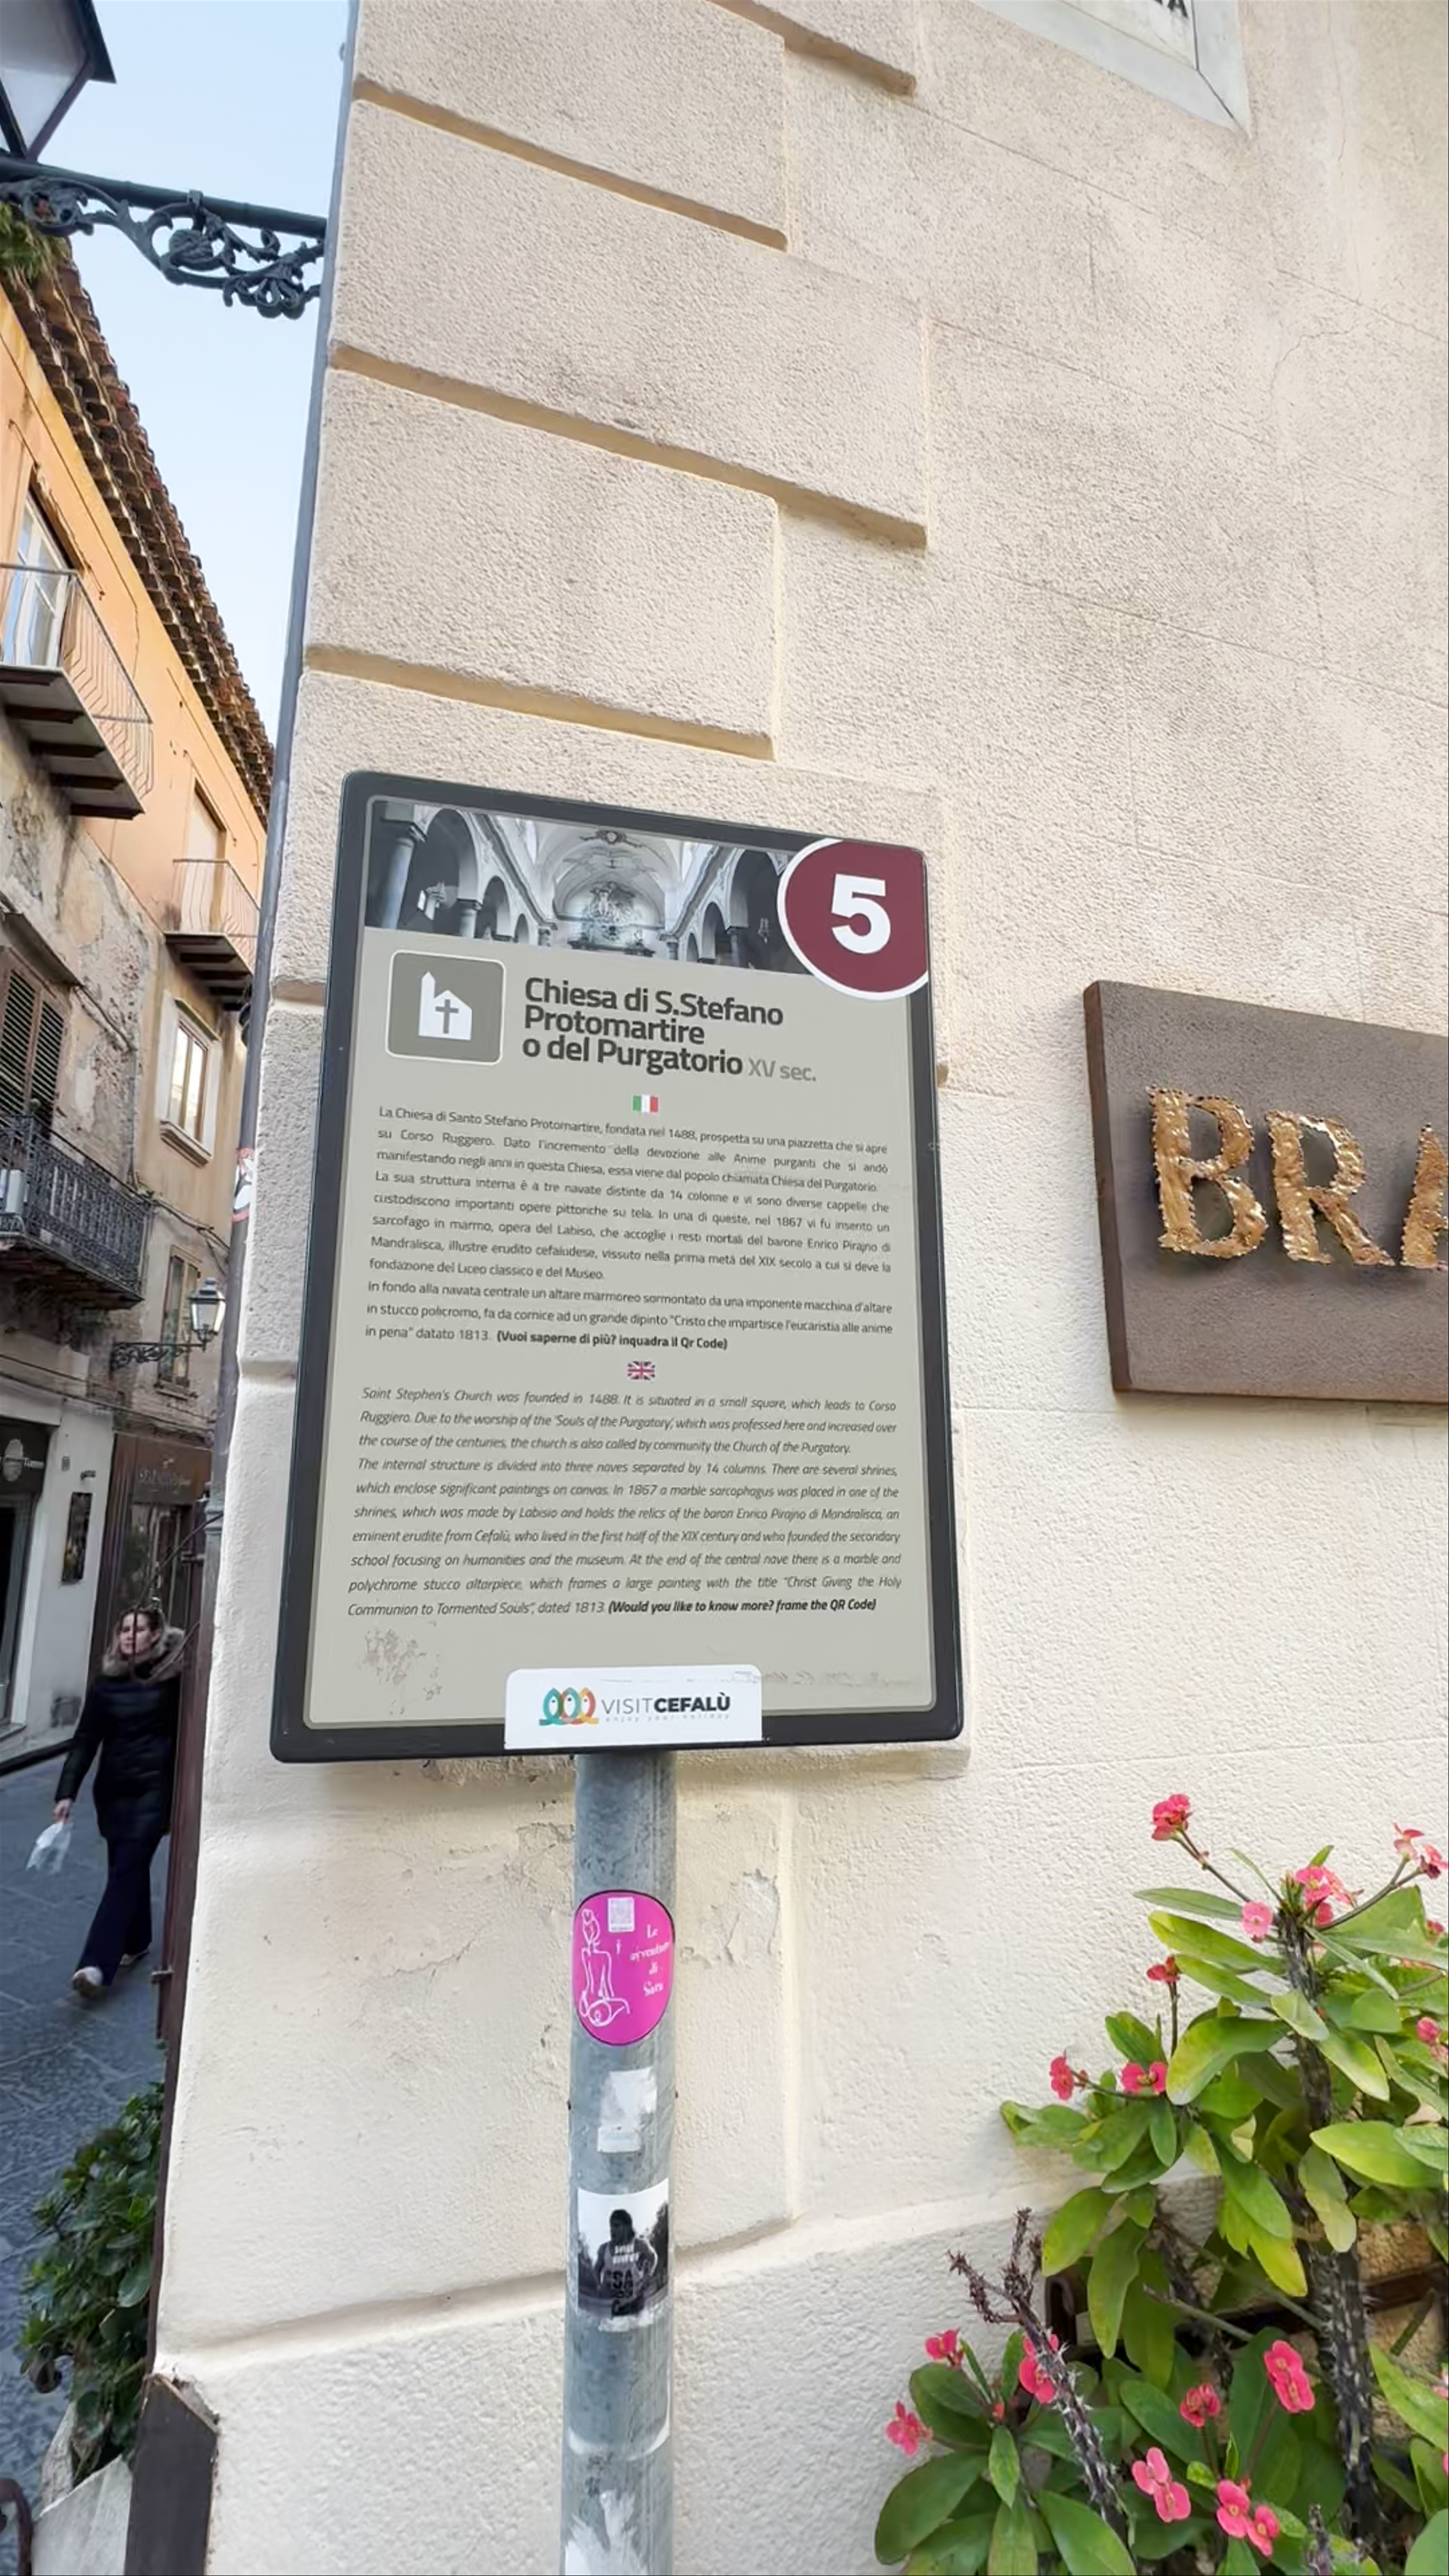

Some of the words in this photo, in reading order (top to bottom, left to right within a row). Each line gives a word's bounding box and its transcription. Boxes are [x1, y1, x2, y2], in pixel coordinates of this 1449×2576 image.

[831, 873, 891, 954] 5
[525, 978, 617, 1009] Chiesa
[624, 988, 648, 1012] di
[655, 991, 783, 1025] S.Stefano
[525, 1005, 705, 1045] Protomartire
[522, 1038, 540, 1057] o
[546, 1035, 589, 1061] del
[597, 1039, 743, 1076] Purgatorio
[748, 1058, 775, 1078] XV
[780, 1063, 817, 1082] sec.
[379, 1106, 393, 1118] La
[395, 1107, 433, 1121] Chiesa
[435, 1111, 446, 1122] di
[448, 1111, 483, 1124] Santo
[483, 1114, 528, 1127] Stefano
[530, 1118, 603, 1135] Protomartire,
[605, 1122, 646, 1137] fondata
[648, 1127, 665, 1137] nel
[669, 1129, 697, 1141] 1488,
[700, 1133, 750, 1145] prospetta
[752, 1137, 765, 1146] su
[766, 1138, 786, 1147] una
[788, 1138, 834, 1150] piazzetta
[835, 1140, 853, 1152] che
[855, 1143, 864, 1152] si
[865, 1144, 887, 1156] apre
[378, 1130, 392, 1139] su
[400, 1129, 434, 1142] Corso
[442, 1132, 495, 1148] Ruggiero.
[503, 1137, 531, 1149] Dato
[614, 1144, 639, 1157] della
[646, 1147, 700, 1161] devozione
[708, 1151, 726, 1162] alle
[734, 1153, 766, 1165] Anime
[773, 1158, 816, 1170] purganti
[823, 1159, 841, 1170] che
[848, 1162, 856, 1171] si
[863, 1163, 888, 1174] andò
[369, 1257, 435, 1272] fondazione
[437, 1261, 455, 1273] del
[457, 1262, 487, 1276] Liceo
[489, 1264, 534, 1277] classico
[535, 1268, 543, 1277] e
[545, 1266, 563, 1277] del
[382, 1280, 417, 1293] fondo
[419, 1283, 439, 1295] alla
[441, 1286, 481, 1297] navata
[483, 1287, 530, 1298] centrale
[531, 1289, 547, 1298] un
[548, 1288, 581, 1300] altare
[583, 1292, 641, 1303] marmoreo
[643, 1295, 707, 1306] sormontato
[709, 1295, 722, 1307] da
[723, 1298, 744, 1308] una
[746, 1298, 803, 1310] imponente
[804, 1300, 853, 1312] macchina
[365, 1325, 377, 1336] in
[415, 1327, 455, 1340] datato
[497, 1330, 528, 1343] (Vuoi
[530, 1333, 577, 1346] saperne
[579, 1333, 591, 1344] di
[592, 1333, 617, 1347] più?
[619, 1334, 669, 1349] inquadra
[671, 1336, 678, 1347] il
[680, 1336, 695, 1350] Qr
[696, 1337, 728, 1351] Code)
[361, 1387, 392, 1400] Saint
[454, 1389, 492, 1402] Church
[497, 1393, 520, 1403] was
[524, 1391, 570, 1405] founded
[573, 1395, 583, 1404] in
[623, 1395, 632, 1406] It
[636, 1396, 644, 1405] is
[648, 1396, 692, 1406] situated
[694, 1398, 705, 1407] in
[708, 1398, 716, 1407] a
[719, 1396, 748, 1408] small
[750, 1399, 787, 1411] square,
[791, 1398, 821, 1410] which
[824, 1399, 852, 1411] leads
[855, 1401, 865, 1411] to
[868, 1400, 896, 1412] Corso
[358, 1458, 379, 1470] The
[382, 1459, 427, 1470] internal
[429, 1460, 481, 1471] structure
[483, 1461, 493, 1472] is
[497, 1459, 538, 1471] divided
[540, 1461, 562, 1472] into
[565, 1460, 594, 1473] three
[596, 1463, 629, 1473] naves
[631, 1461, 686, 1476] separated
[688, 1462, 701, 1476] by
[707, 1463, 719, 1474] 14
[772, 1463, 800, 1475] There
[802, 1466, 820, 1475] are
[822, 1464, 859, 1475] several
[860, 1464, 897, 1477] shrines,
[356, 1481, 391, 1494] which
[393, 1482, 437, 1495] enclose
[439, 1482, 497, 1497] significant
[498, 1484, 550, 1498] paintings
[553, 1486, 568, 1495] on
[629, 1484, 658, 1496] 1867
[659, 1487, 668, 1496] a
[669, 1484, 707, 1496] marble
[709, 1486, 775, 1500] sarcophagus
[777, 1487, 799, 1497] was
[800, 1486, 835, 1500] placed
[835, 1486, 847, 1497] in
[849, 1488, 868, 1497] one
[870, 1486, 881, 1500] of
[883, 1486, 899, 1498] the
[348, 1604, 418, 1616] Communion
[420, 1604, 434, 1615] to
[437, 1601, 499, 1615] Tormented
[537, 1601, 572, 1614] dated
[608, 1600, 650, 1615] (Would
[651, 1602, 672, 1615] you
[672, 1600, 694, 1612] like
[694, 1601, 707, 1612] to
[708, 1600, 739, 1612] know
[740, 1599, 775, 1611] more?
[775, 1599, 809, 1614] frame
[810, 1598, 828, 1610] the
[829, 1598, 846, 1612] QR
[847, 1598, 877, 1611] Code)
